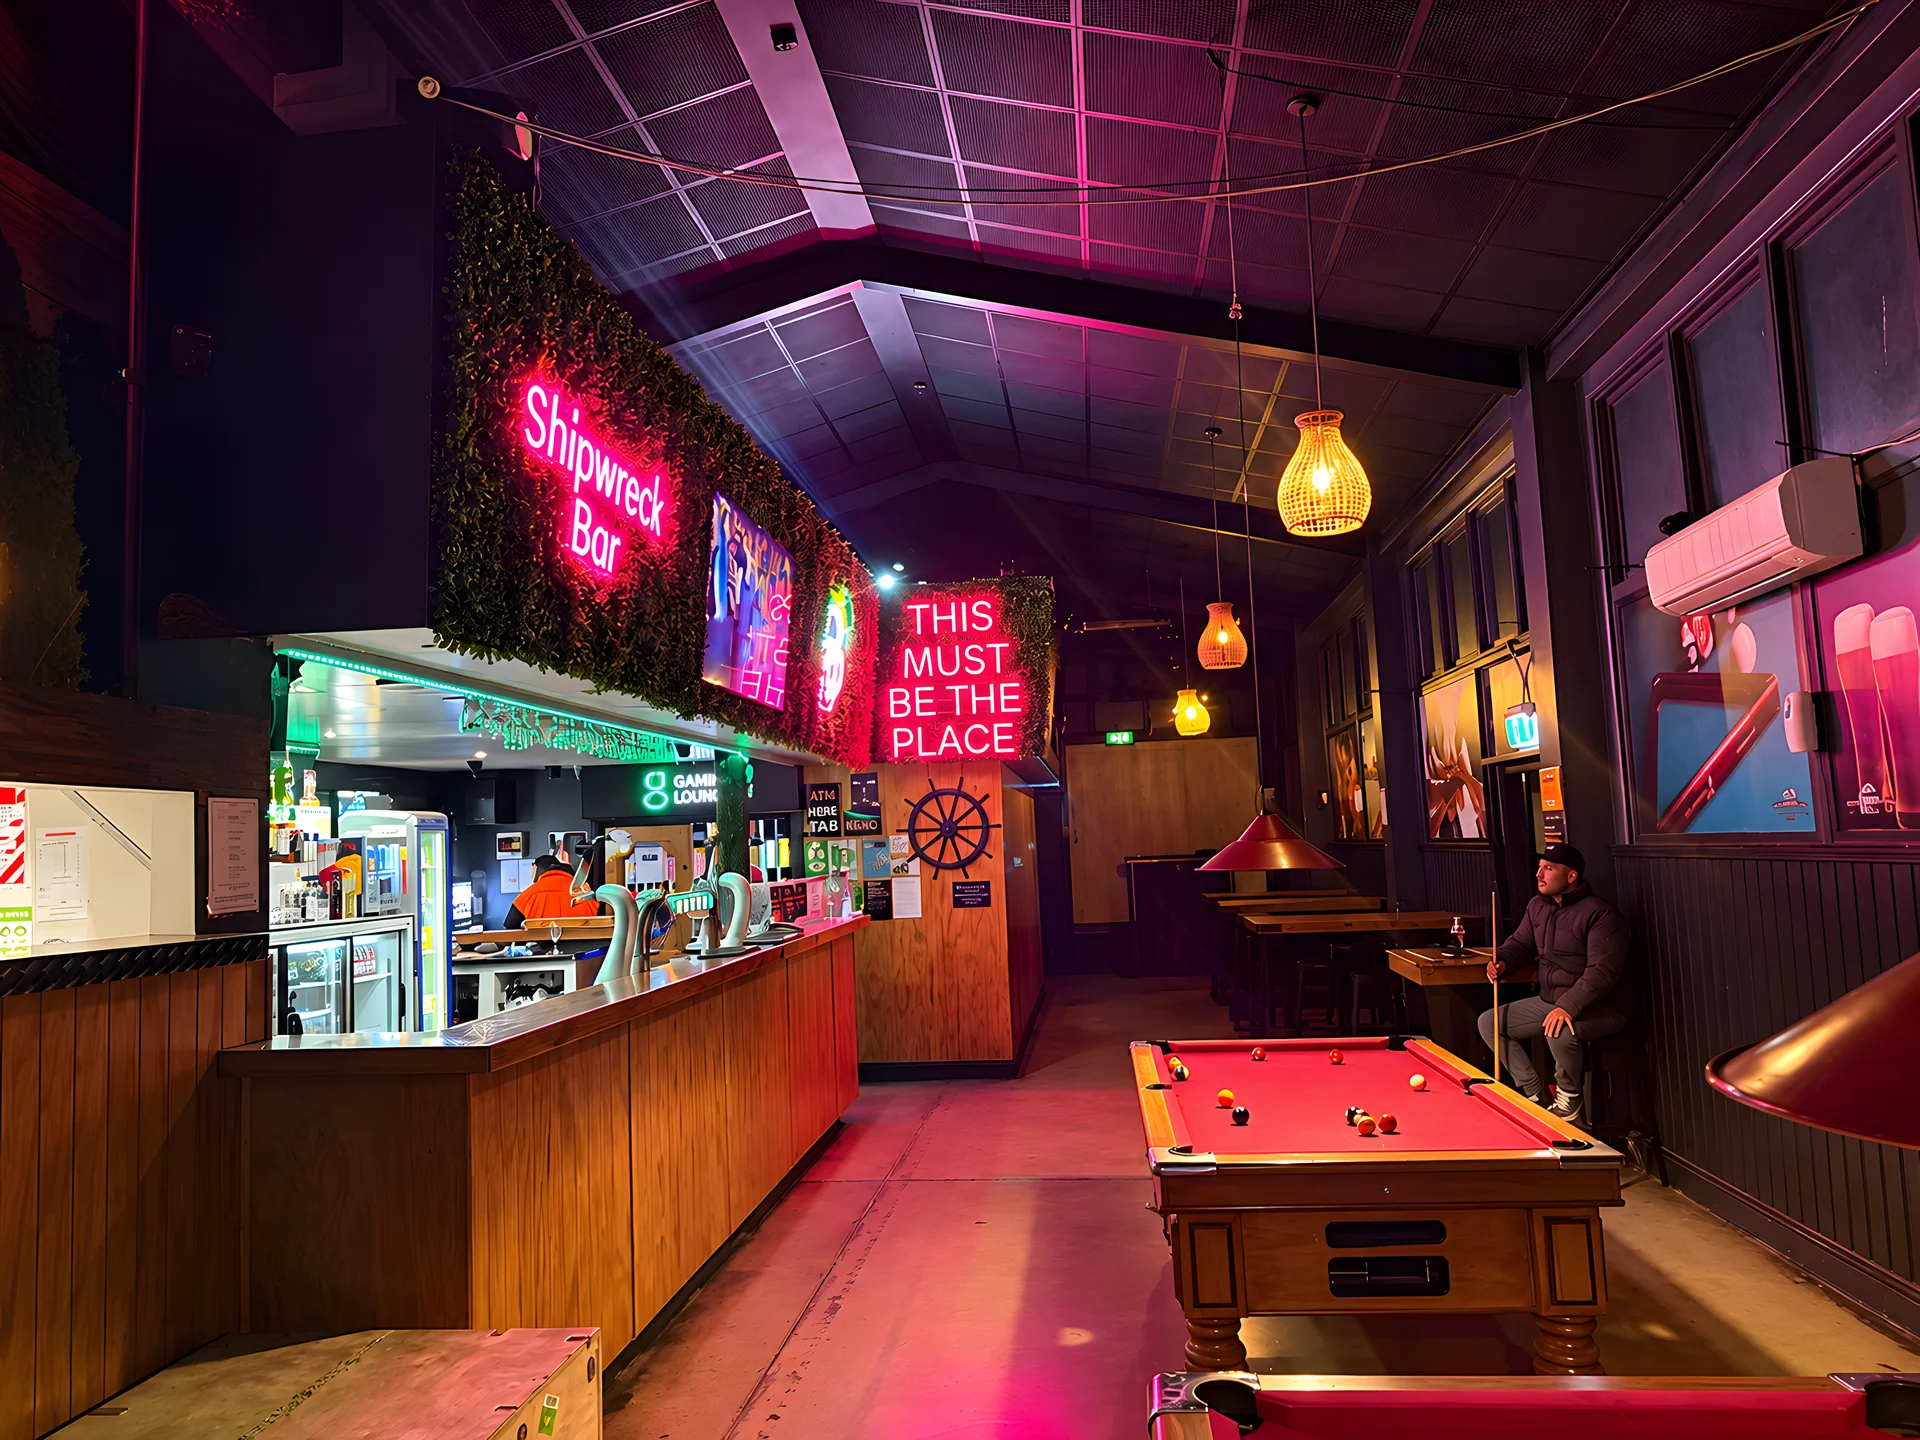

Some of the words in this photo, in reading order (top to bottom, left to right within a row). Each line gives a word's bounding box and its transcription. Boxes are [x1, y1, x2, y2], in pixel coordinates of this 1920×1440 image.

[524, 384, 665, 537] Shipwreck
[571, 497, 621, 573] Bar
[906, 600, 993, 635] THIS
[903, 642, 1009, 679] MUST
[889, 686, 936, 718] BE
[945, 682, 1022, 716] THE
[892, 722, 1015, 758] PLACE
[809, 820, 839, 833] TAB
